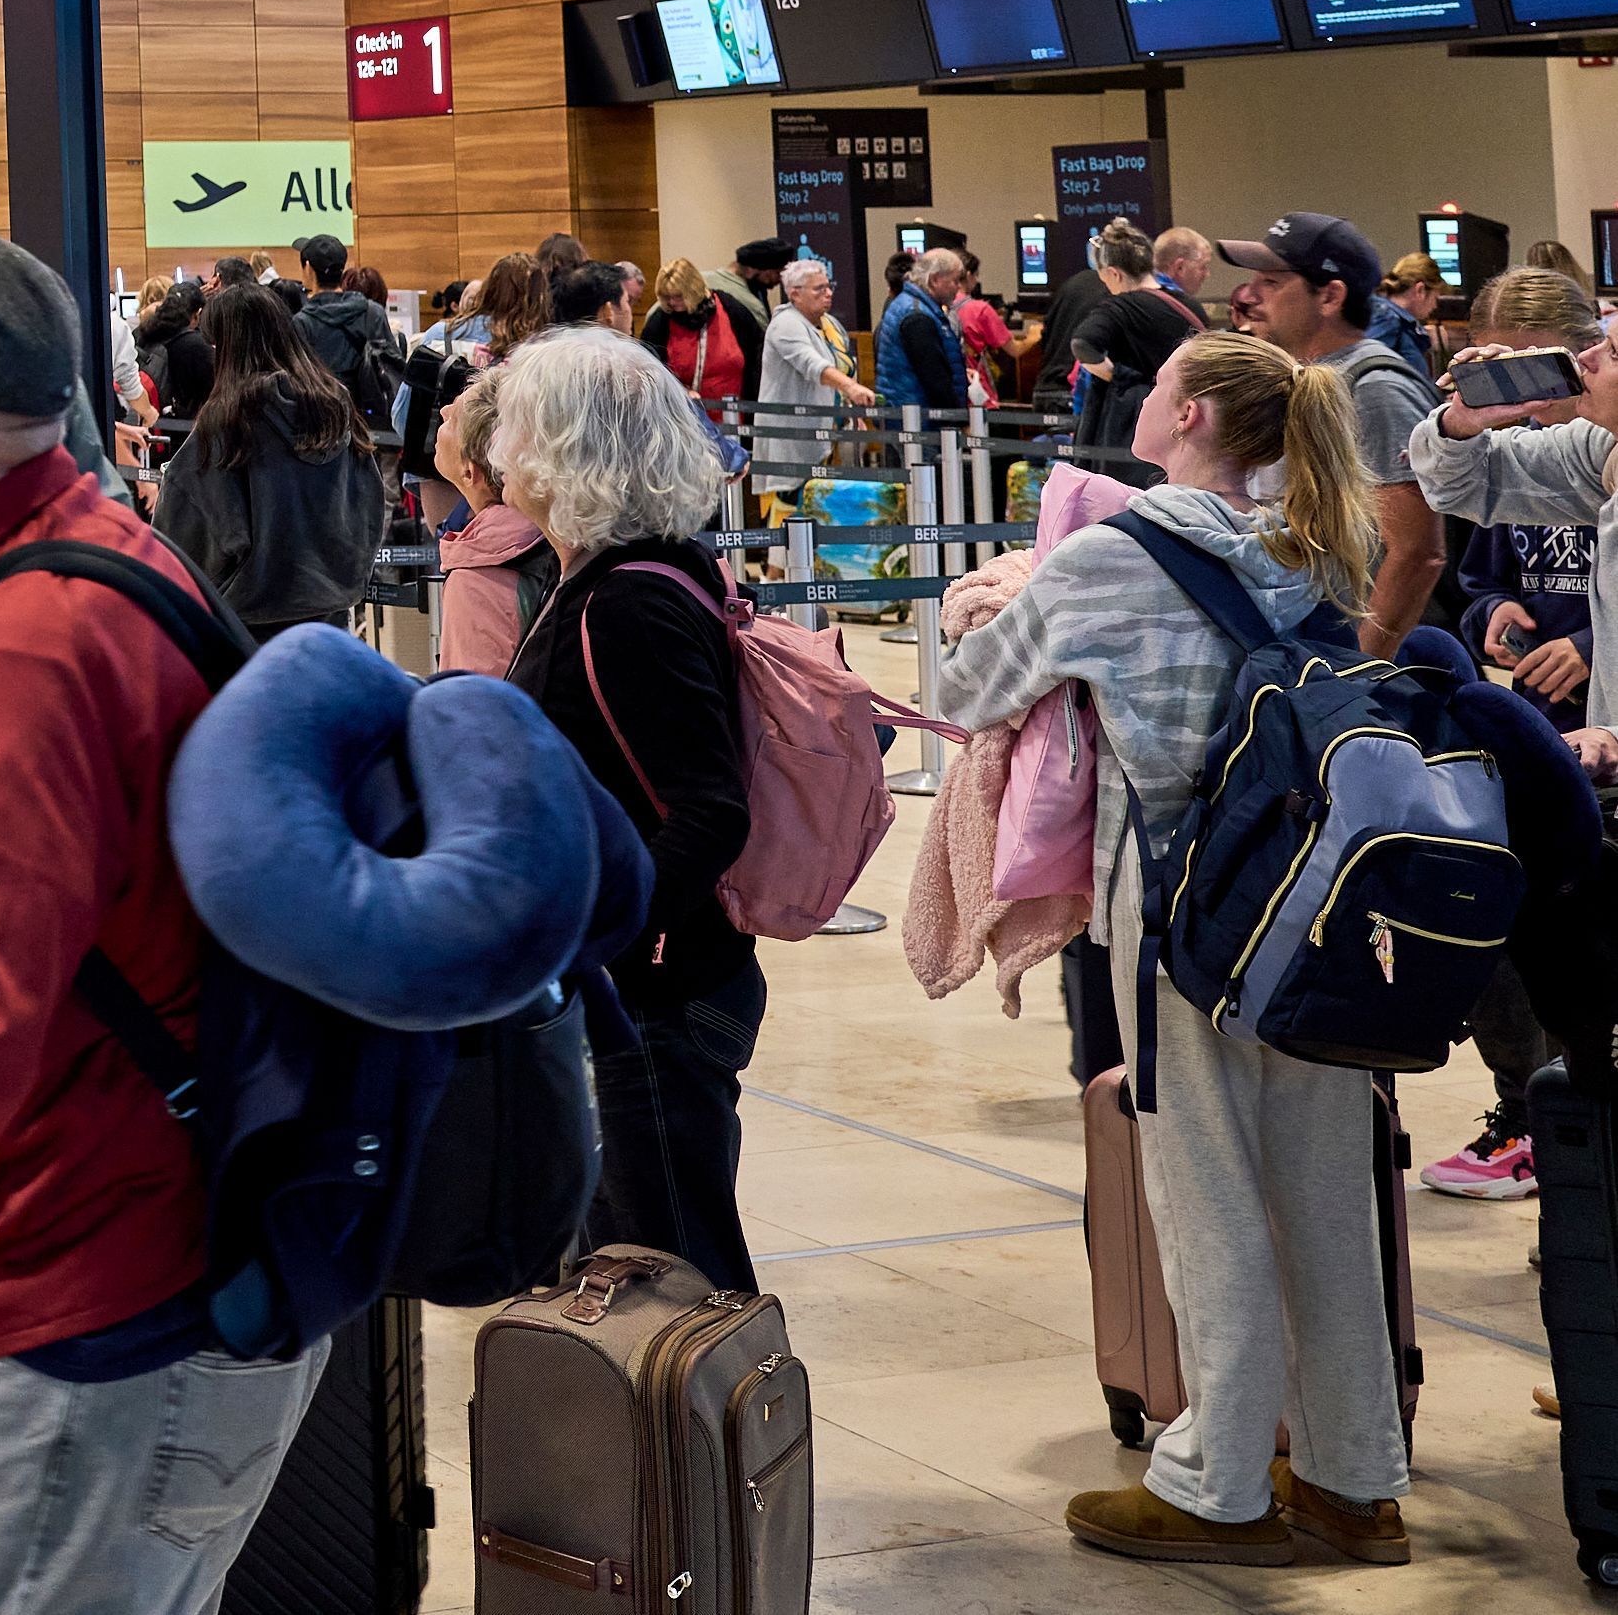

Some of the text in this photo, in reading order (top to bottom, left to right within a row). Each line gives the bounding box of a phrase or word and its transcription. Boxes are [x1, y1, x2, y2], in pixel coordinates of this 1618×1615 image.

[356, 30, 403, 53] Check-in
[423, 26, 442, 94] 1
[778, 169, 844, 188] Fast Bag Drop
[281, 167, 353, 212] All
[779, 189, 810, 207] Step 2
[810, 464, 828, 479] BER
[715, 531, 743, 547] BER
[914, 527, 939, 542] BER
[1555, 575, 1589, 592] SHOWCAS
[806, 584, 838, 602] BER
